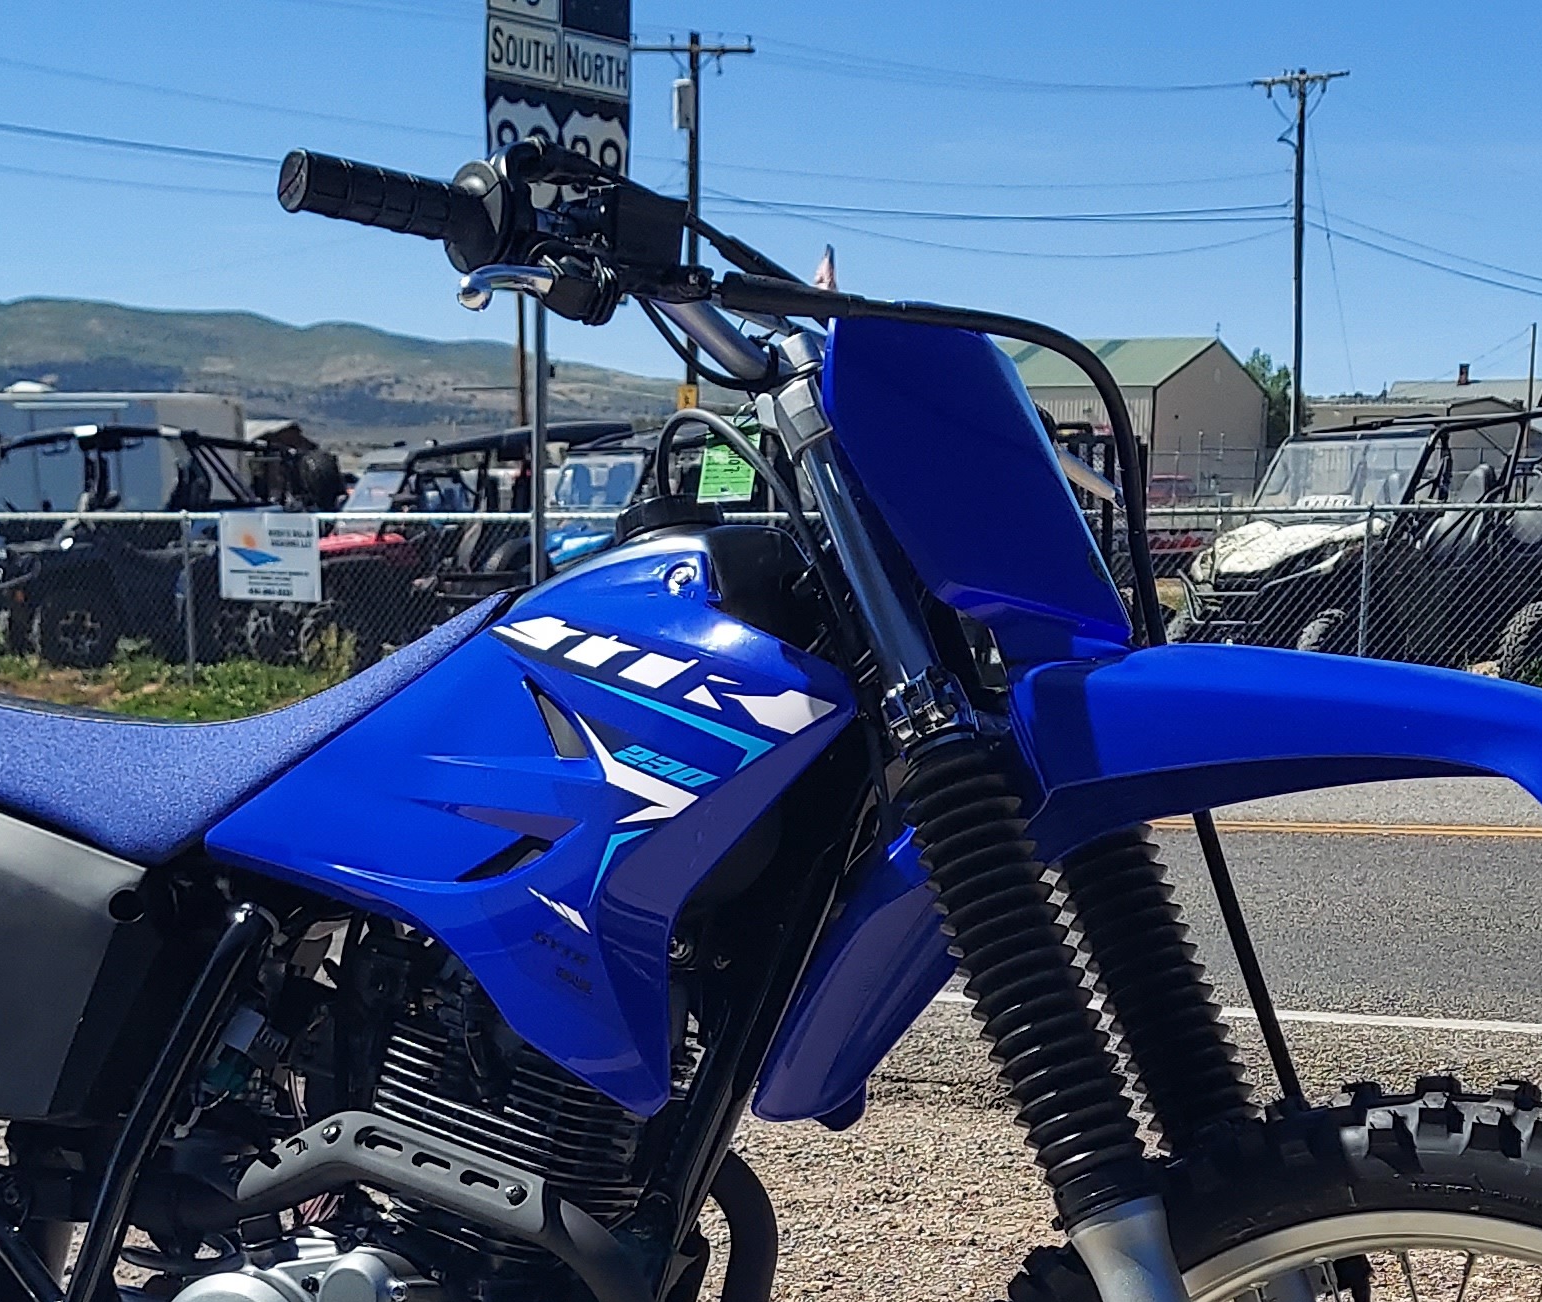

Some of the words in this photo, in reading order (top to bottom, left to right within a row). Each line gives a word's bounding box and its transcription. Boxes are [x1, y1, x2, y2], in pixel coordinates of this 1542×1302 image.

[491, 25, 556, 75] SOUTH
[566, 42, 628, 90] NORTH
[611, 743, 722, 788] 230
